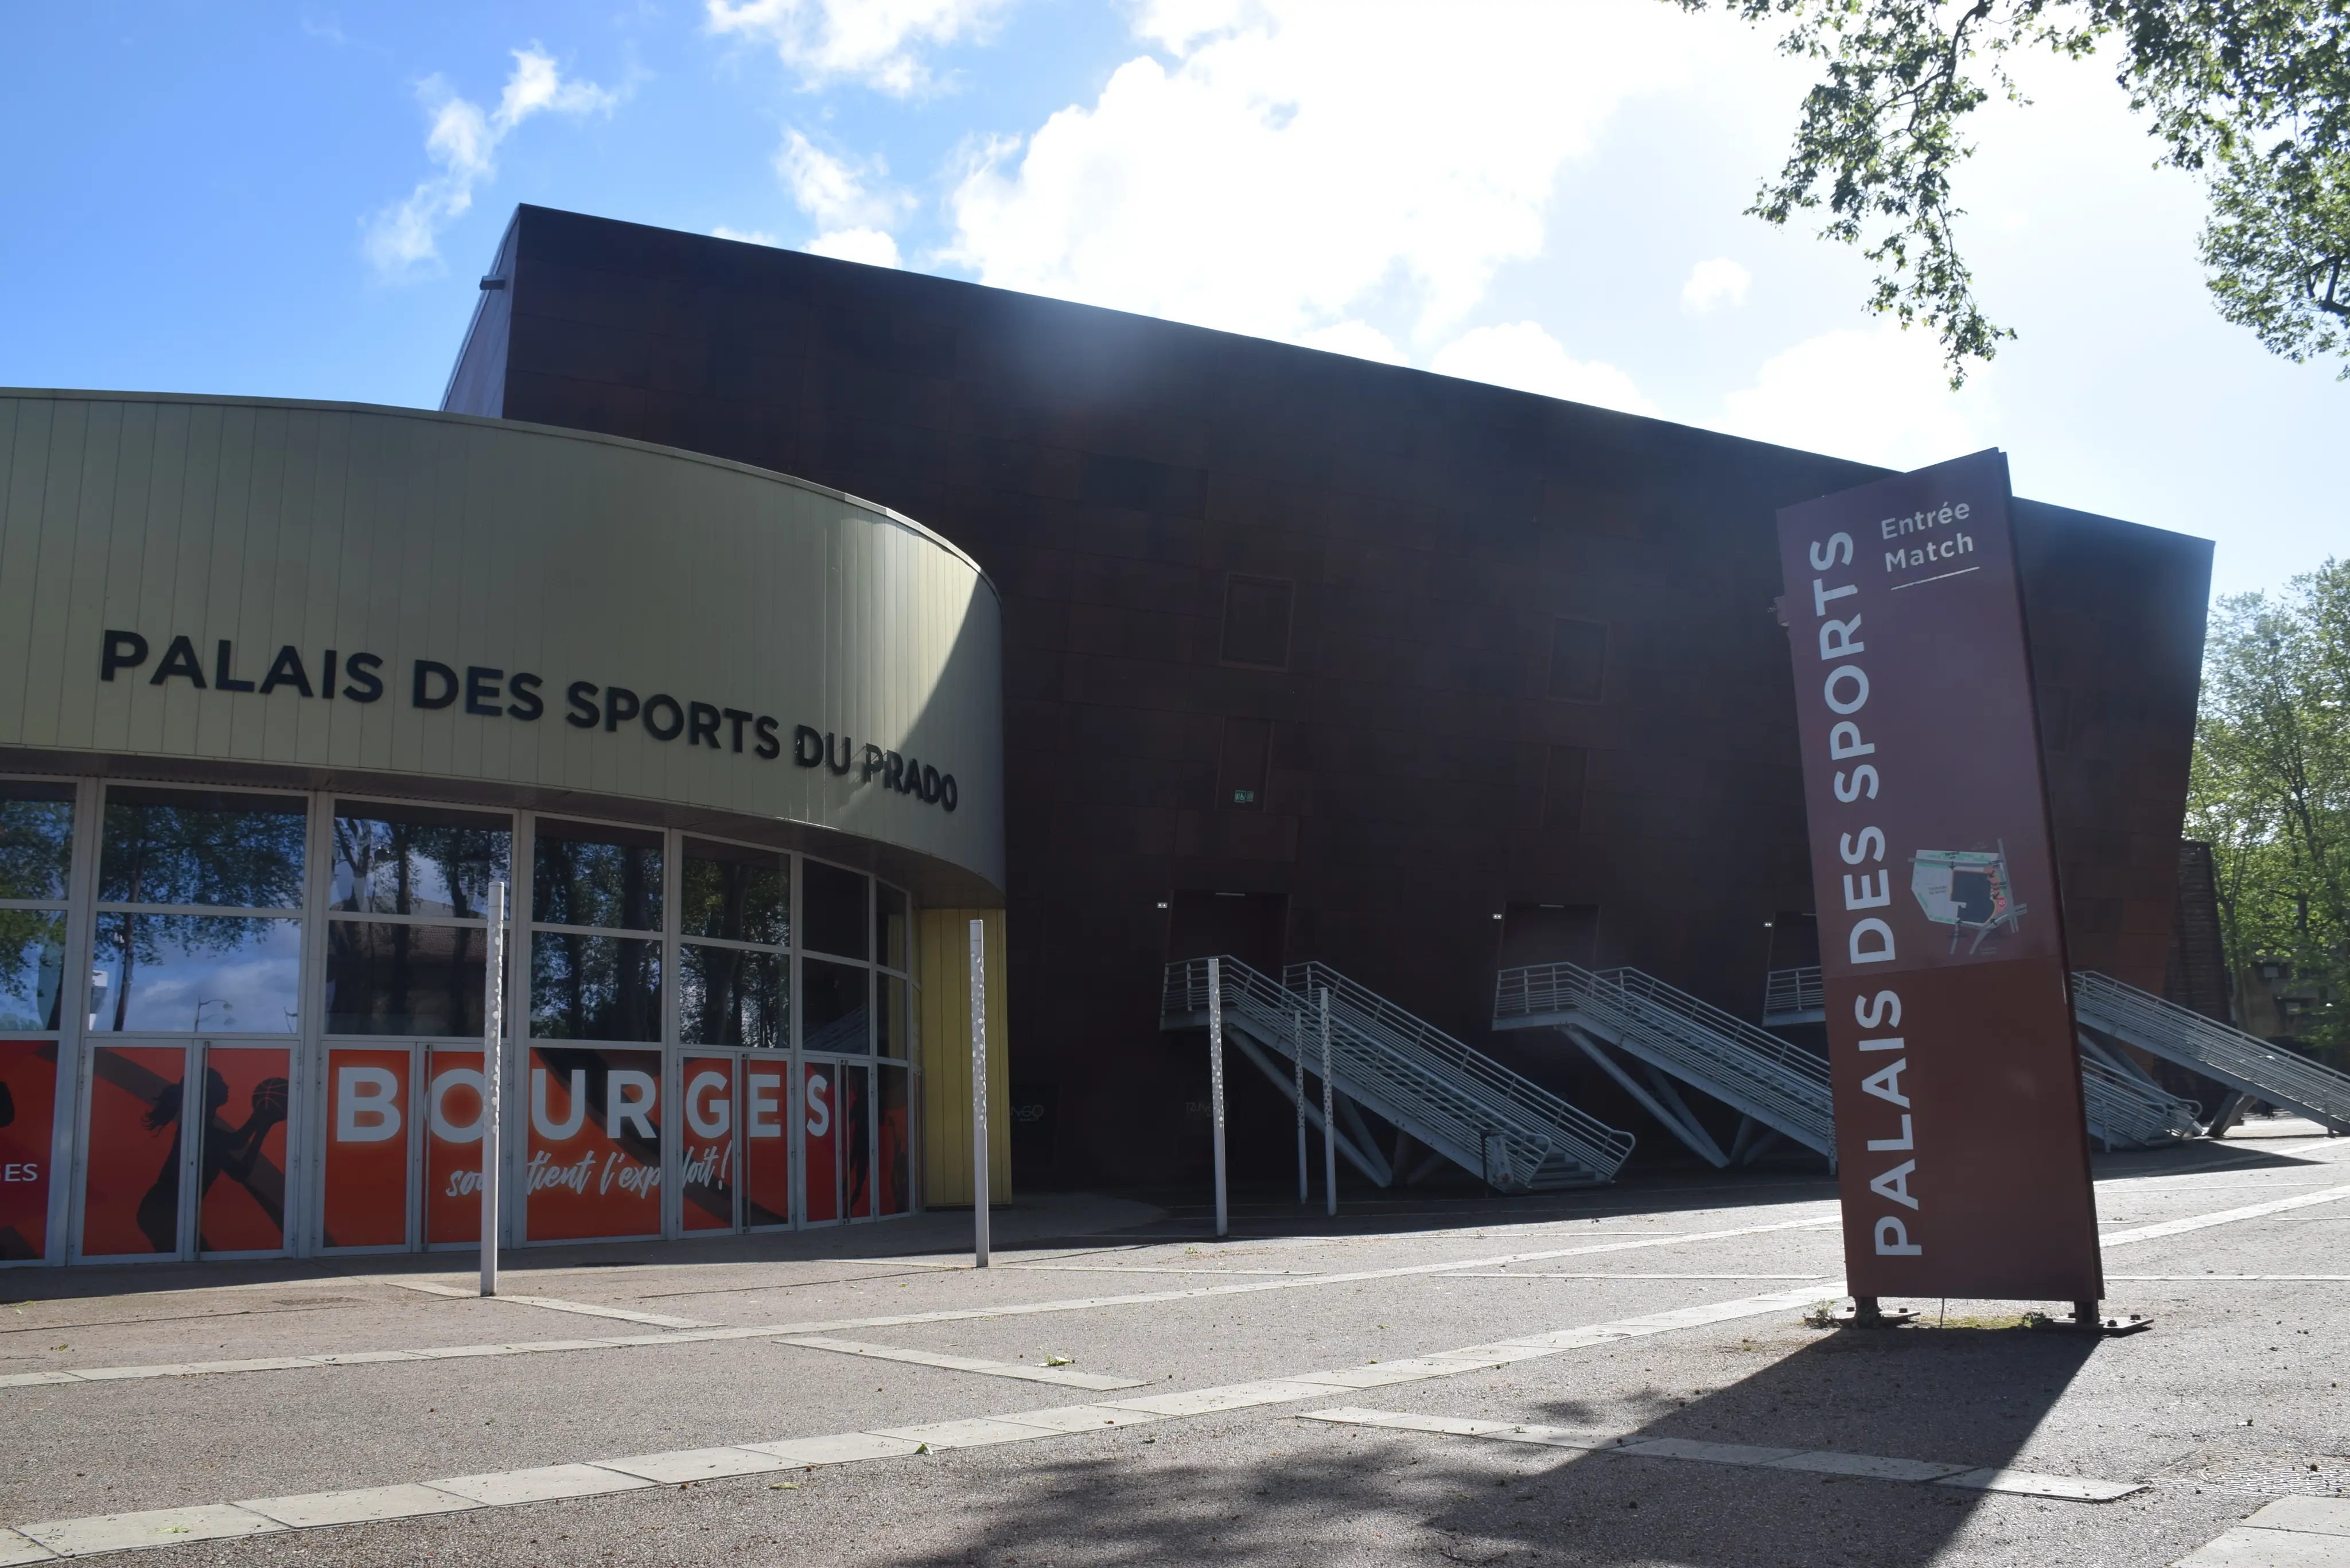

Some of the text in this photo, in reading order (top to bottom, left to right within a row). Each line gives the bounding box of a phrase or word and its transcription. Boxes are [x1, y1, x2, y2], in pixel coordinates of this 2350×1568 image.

[1881, 501, 1970, 540] Entrée
[1885, 533, 1975, 573] Match
[100, 629, 959, 812] PALAIS DES SPORTS DU PRADO
[1810, 531, 1922, 1256] PALAIS DES SPORTS
[336, 1067, 829, 1143] BOURGES
[0, 1163, 38, 1182] ES
